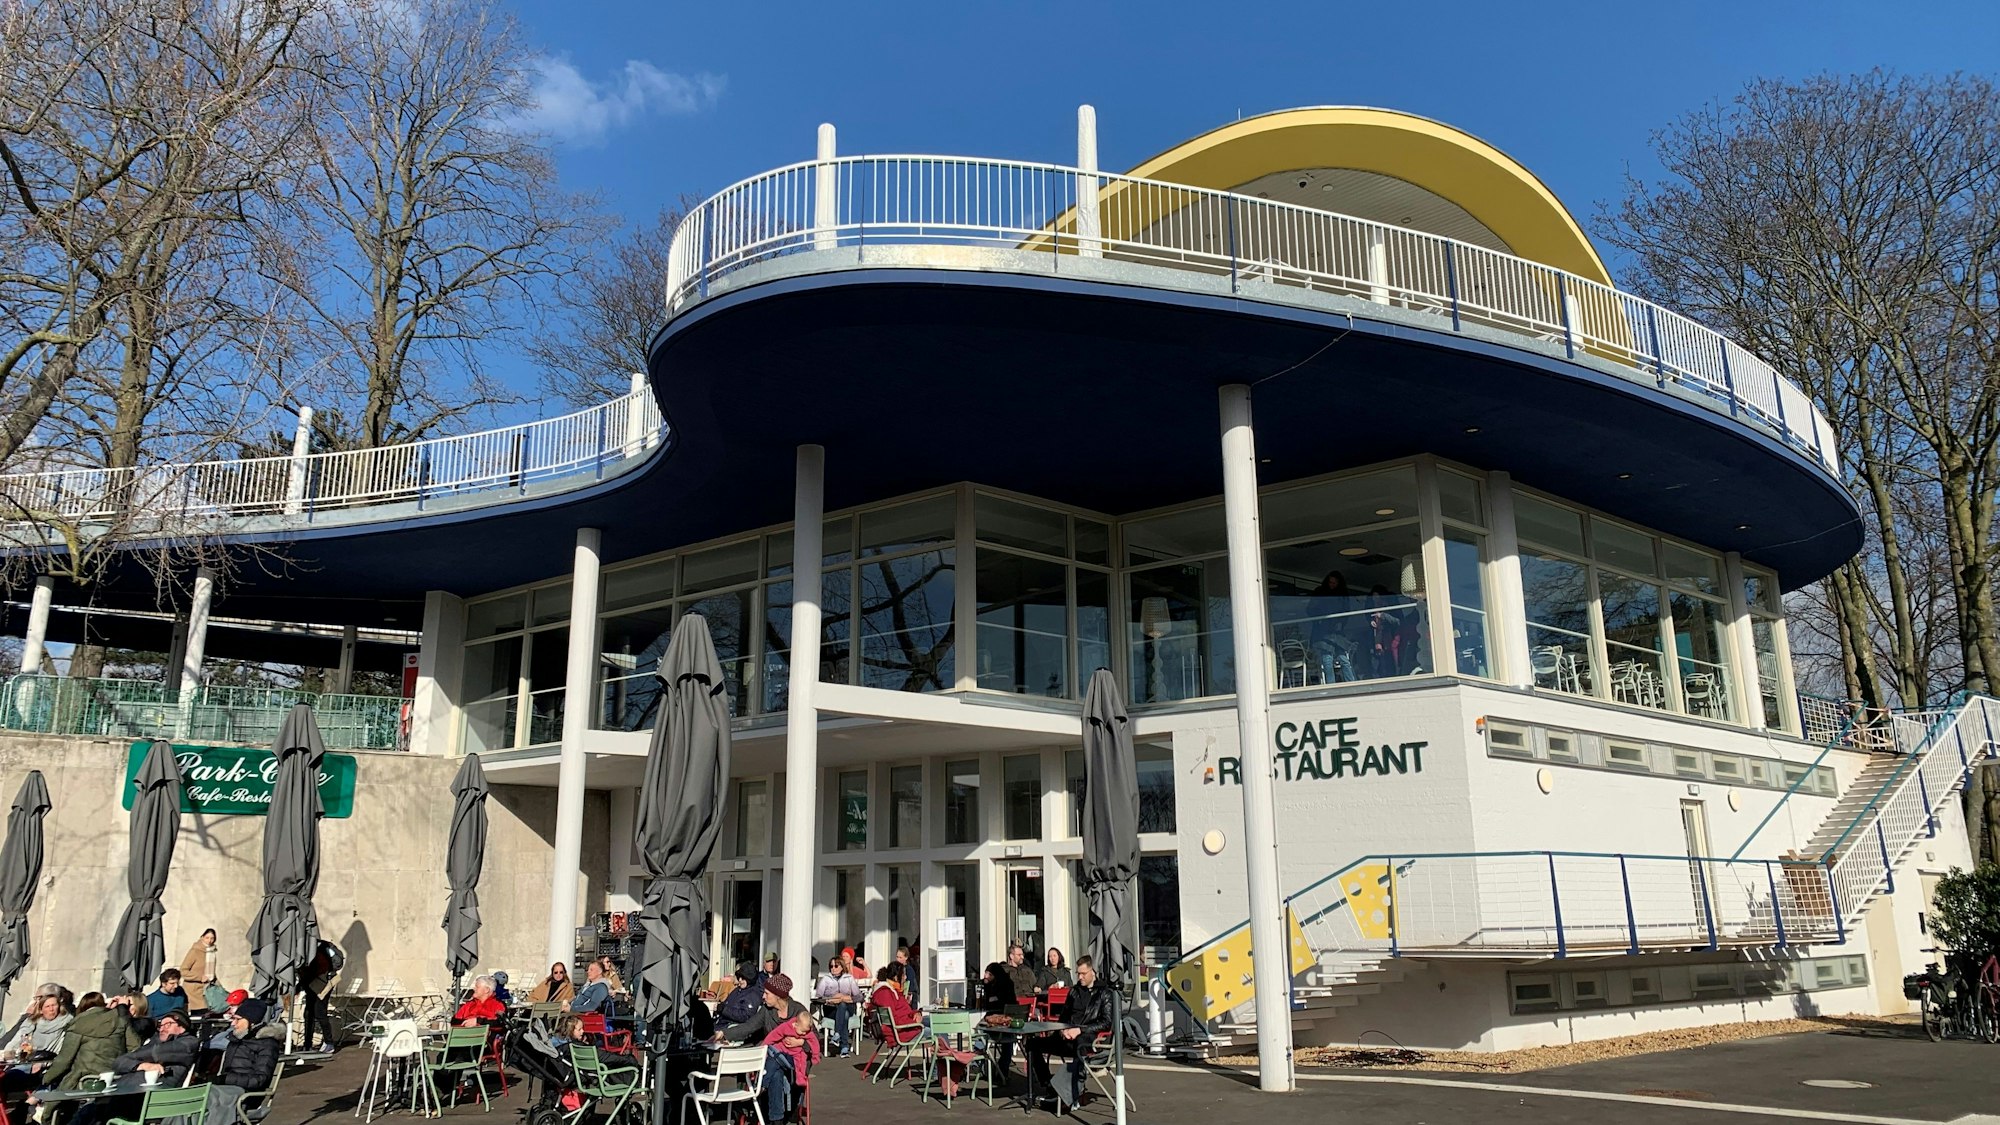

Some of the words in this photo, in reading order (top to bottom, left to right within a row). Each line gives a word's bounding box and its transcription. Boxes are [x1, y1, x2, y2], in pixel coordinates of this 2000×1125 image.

[1275, 717, 1360, 751] CAFE
[175, 752, 335, 786] Park-Ce
[1218, 741, 1428, 786] RTAURANT
[186, 785, 273, 806] Cafe-Resta
